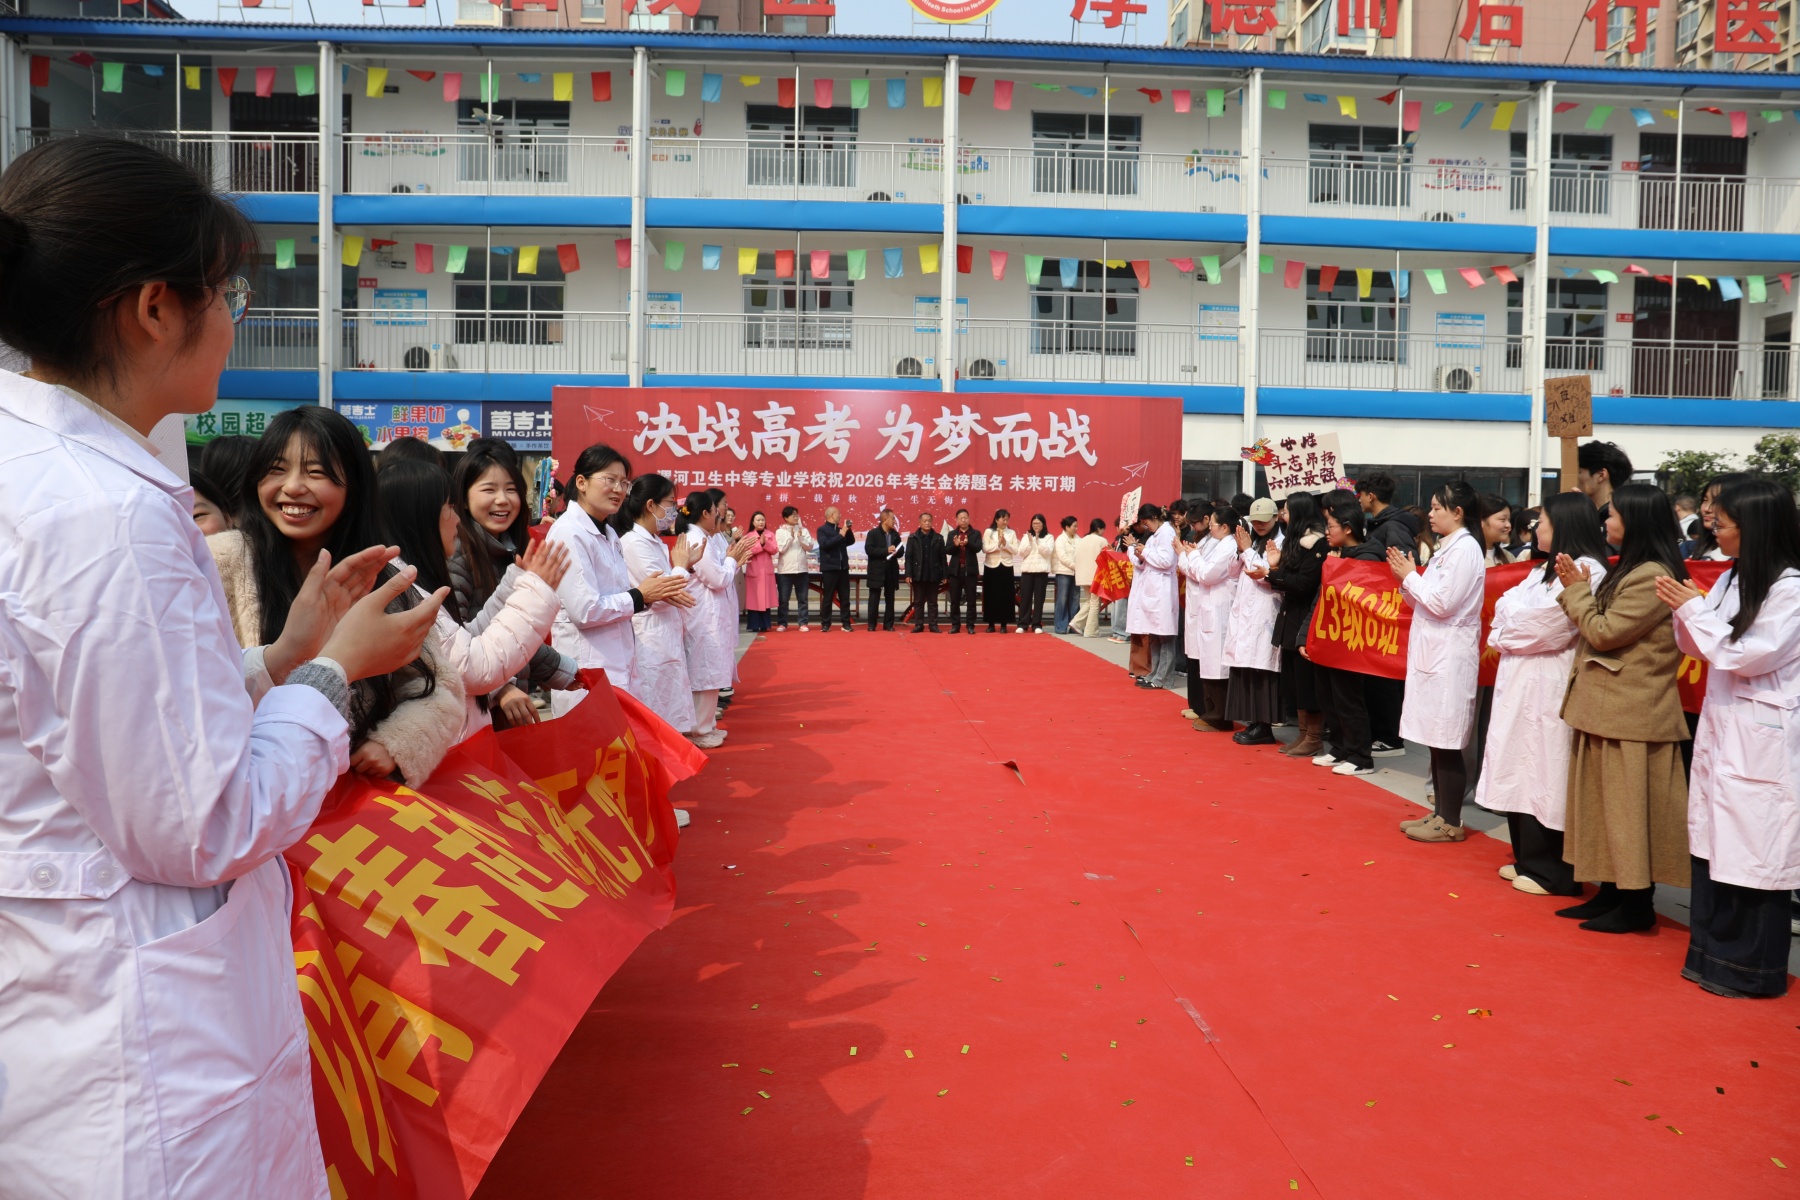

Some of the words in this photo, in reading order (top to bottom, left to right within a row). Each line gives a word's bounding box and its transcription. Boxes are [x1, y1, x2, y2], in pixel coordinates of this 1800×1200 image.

[196, 411, 277, 435] 校园超
[392, 405, 445, 423] 鲜果切
[633, 401, 861, 464] 决战高考
[875, 403, 1098, 467] 为梦而战
[1271, 450, 1336, 475] 斗志昂扬
[1009, 475, 1076, 492] 未来可期
[1268, 467, 1338, 490] 六班最强
